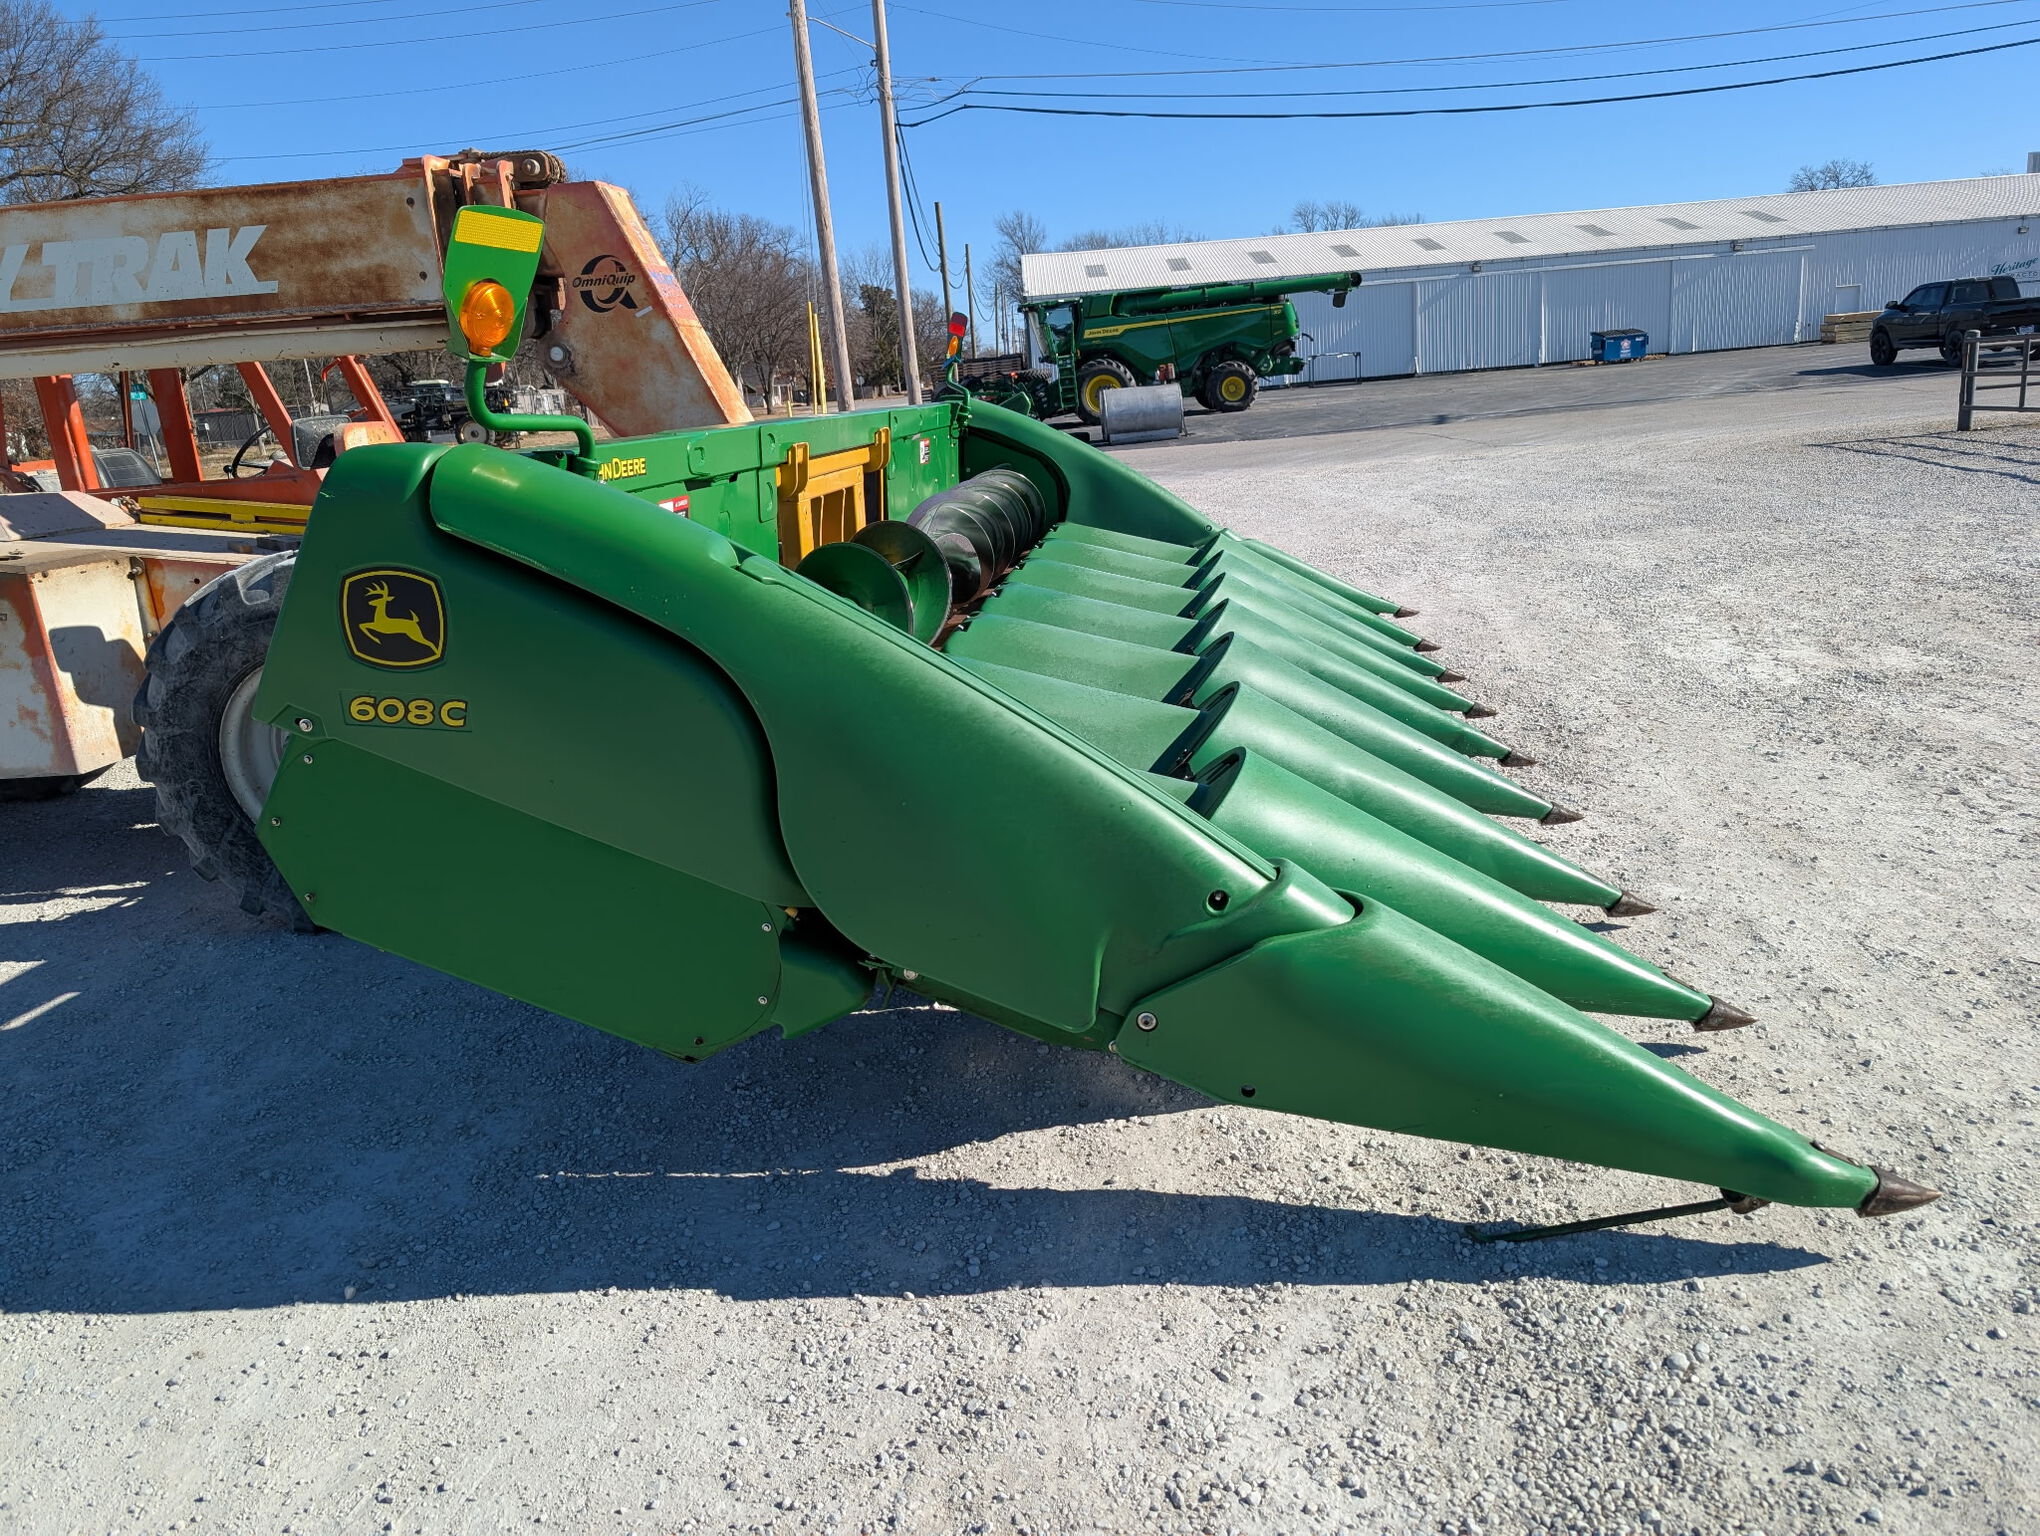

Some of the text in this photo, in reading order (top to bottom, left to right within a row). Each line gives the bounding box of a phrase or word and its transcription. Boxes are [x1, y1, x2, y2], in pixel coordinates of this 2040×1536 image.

[1991, 257, 2039, 275] Heritage
[572, 272, 636, 288] OmniQuip
[612, 457, 646, 479] DEERE
